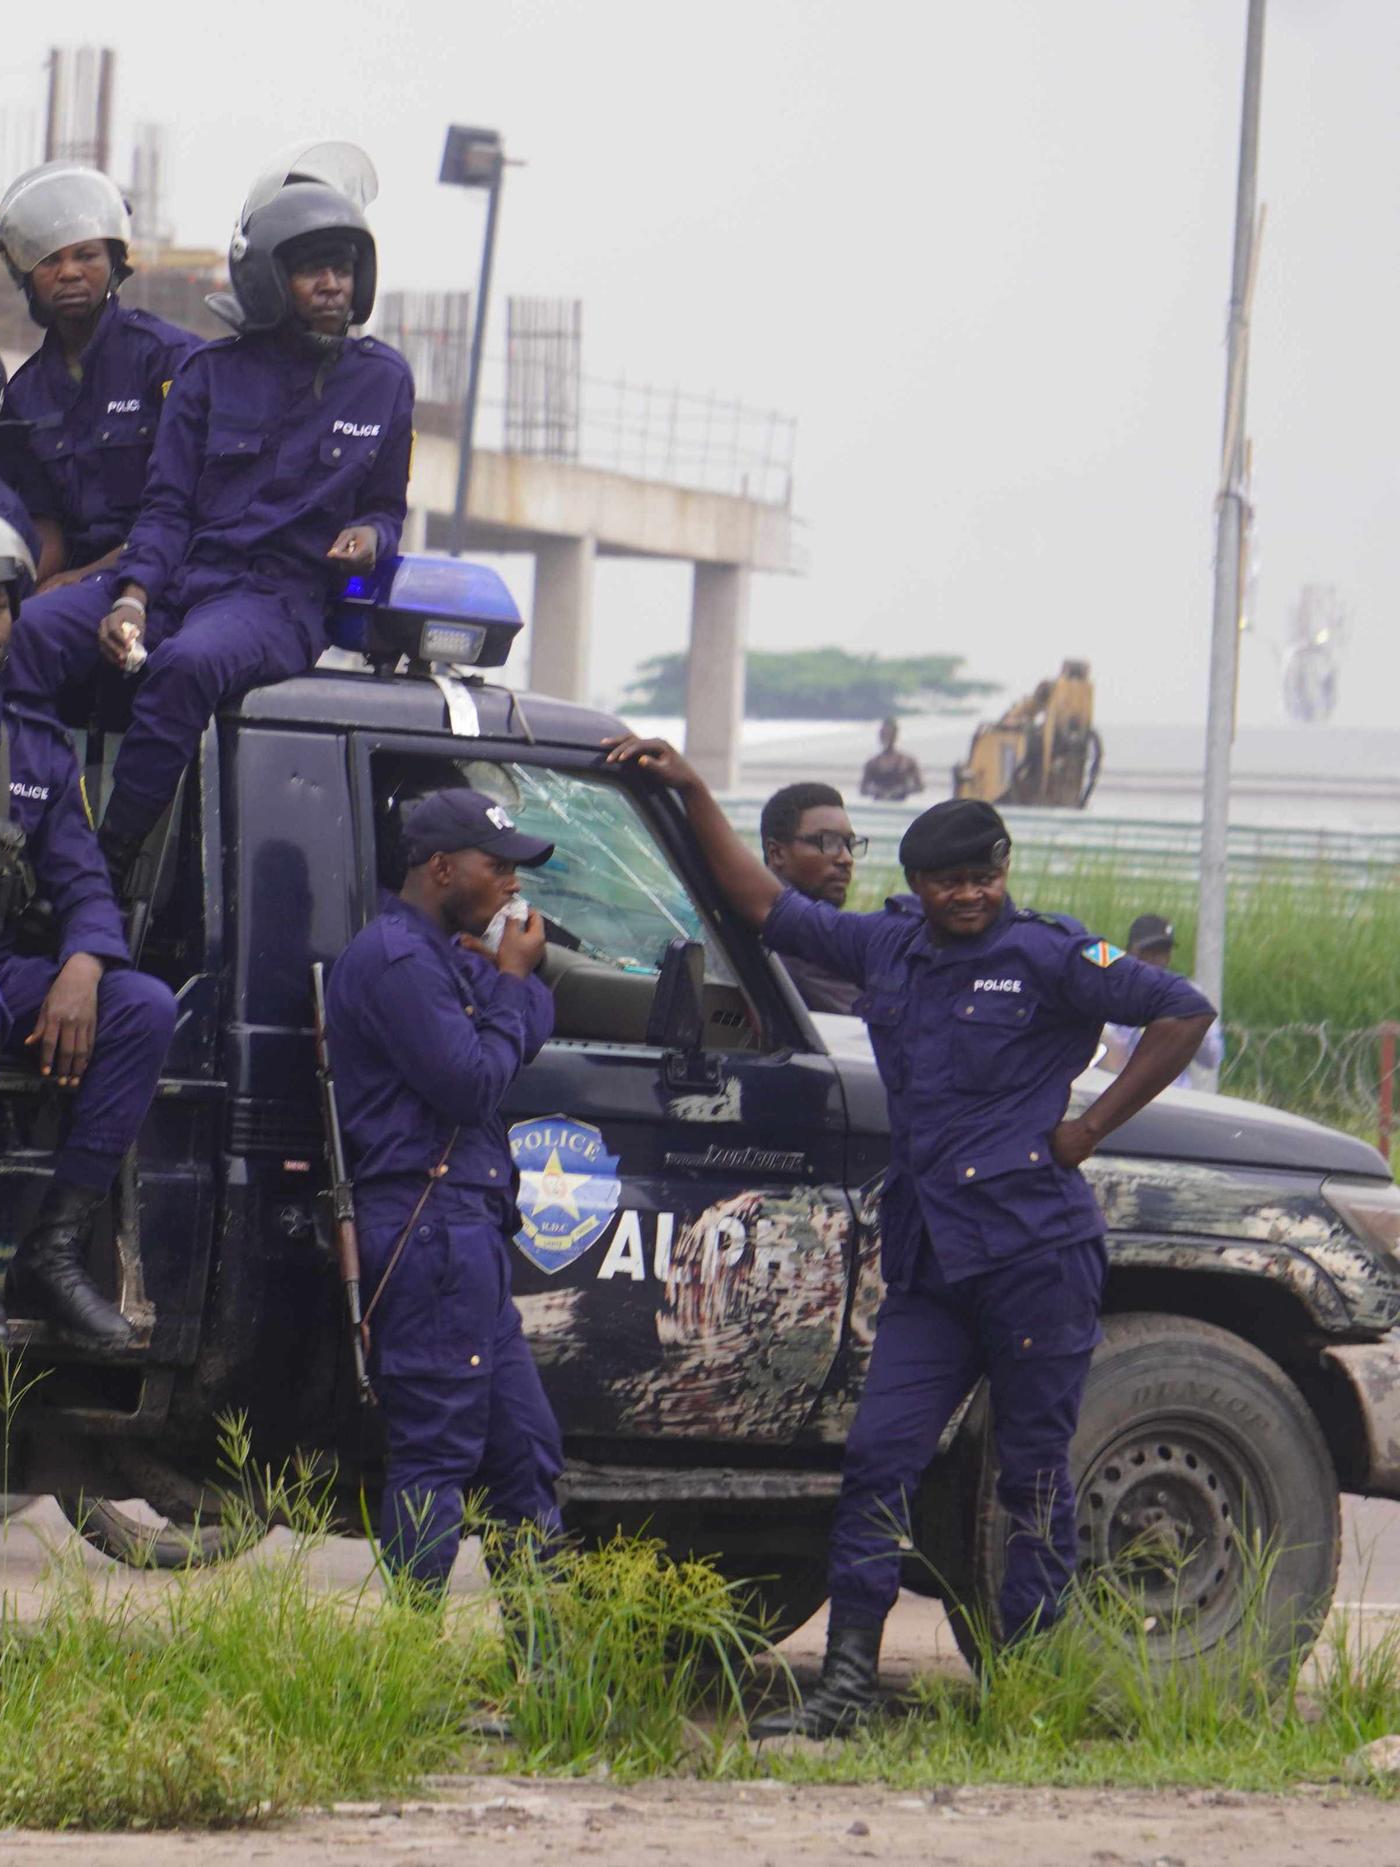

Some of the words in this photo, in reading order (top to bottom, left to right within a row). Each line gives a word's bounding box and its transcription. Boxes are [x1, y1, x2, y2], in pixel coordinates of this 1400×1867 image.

[332, 420, 381, 437] POLICE
[973, 978, 1023, 994] POLICE
[509, 1128, 601, 1163] POLICE
